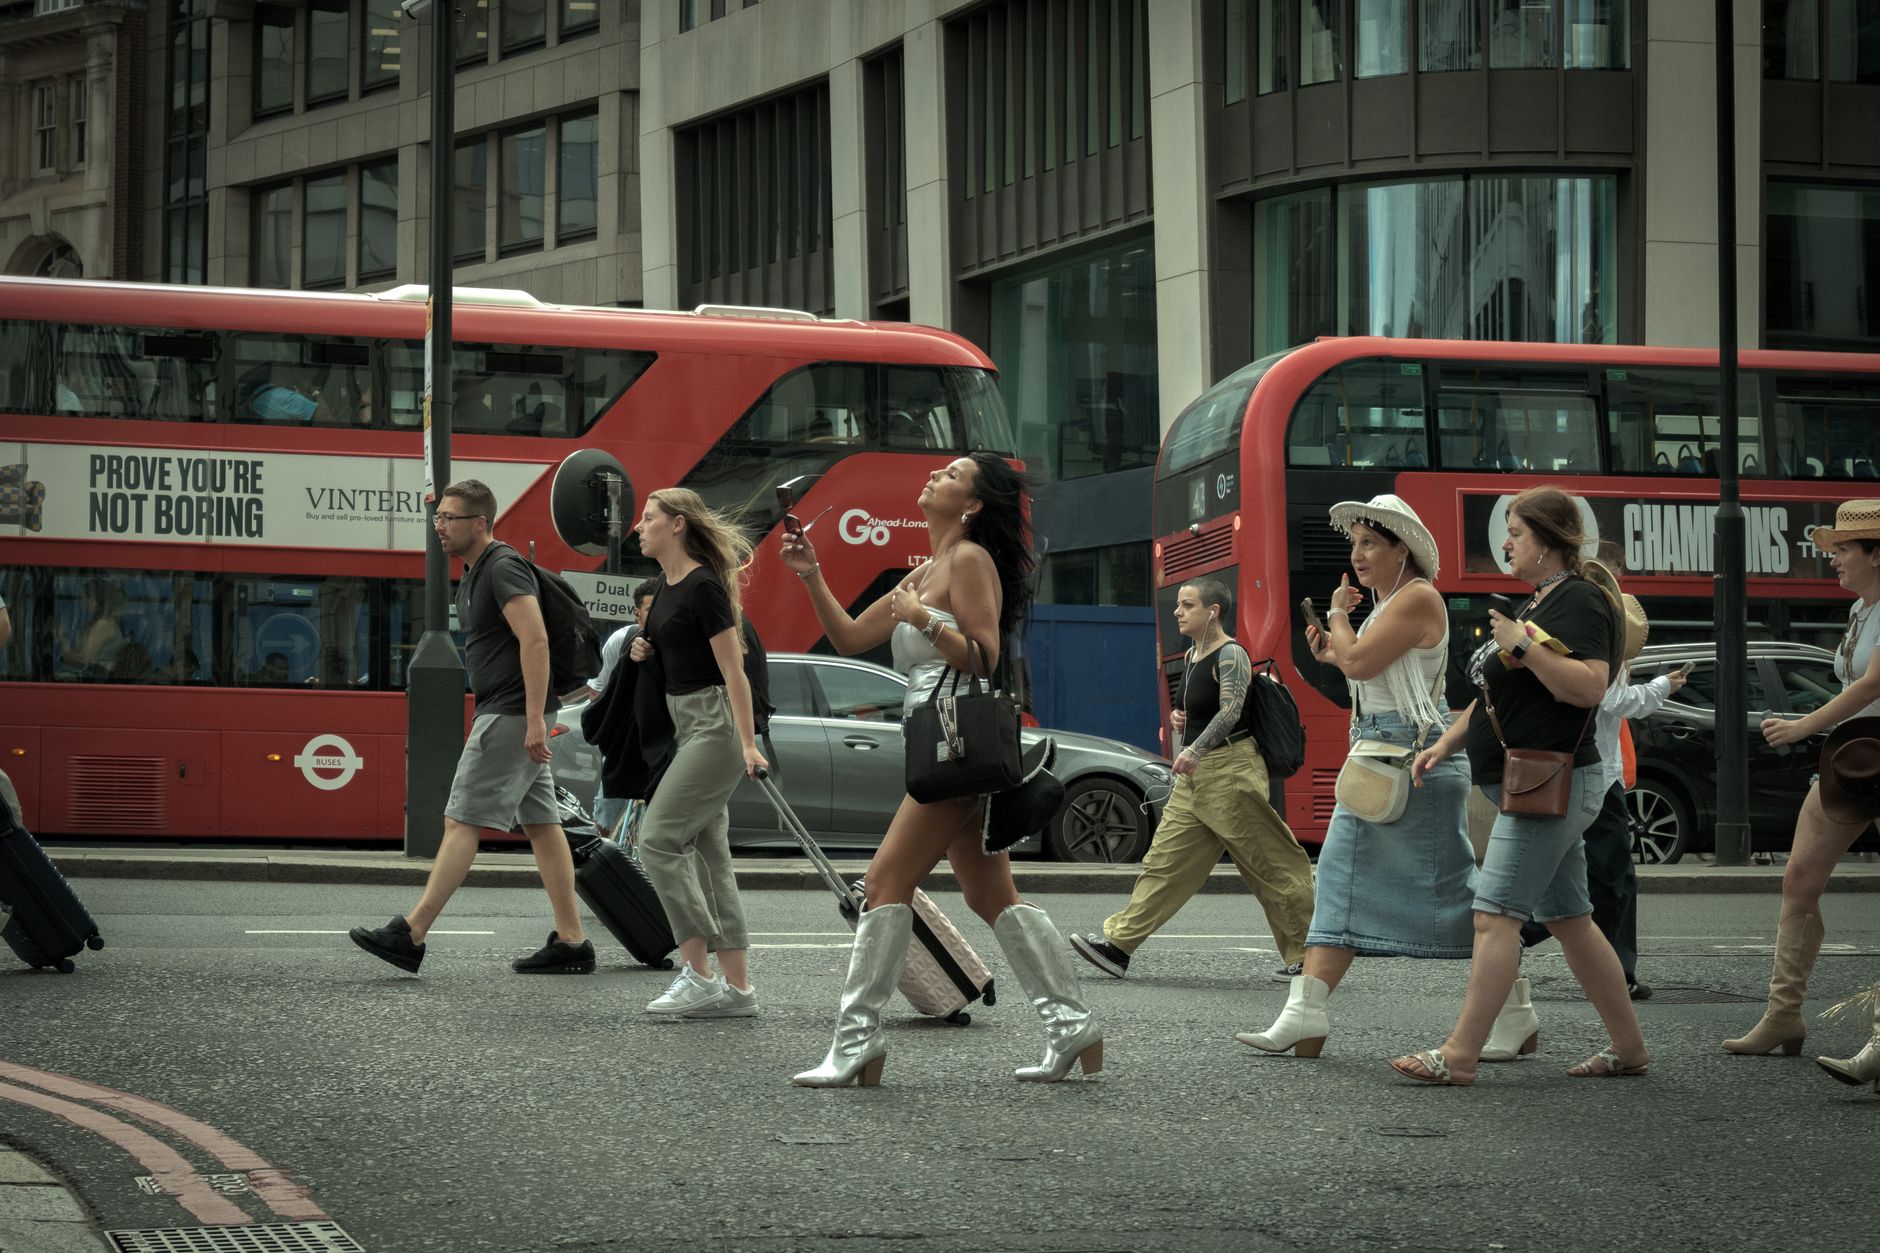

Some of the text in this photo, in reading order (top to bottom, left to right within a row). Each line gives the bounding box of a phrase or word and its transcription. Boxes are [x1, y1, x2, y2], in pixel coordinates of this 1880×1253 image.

[90, 454, 264, 494] PROVE YOU'RE
[89, 491, 264, 538] NOT BORING
[305, 487, 423, 513] VINTERI
[306, 512, 319, 521] Buy
[336, 513, 348, 521] sell
[350, 514, 384, 522] pre-loved
[385, 515, 415, 523] furniture
[838, 508, 929, 546] Go Ahead-Lond
[1623, 503, 1790, 574] CHAMNS
[596, 581, 630, 596] Dual
[316, 758, 341, 767] BUSES
